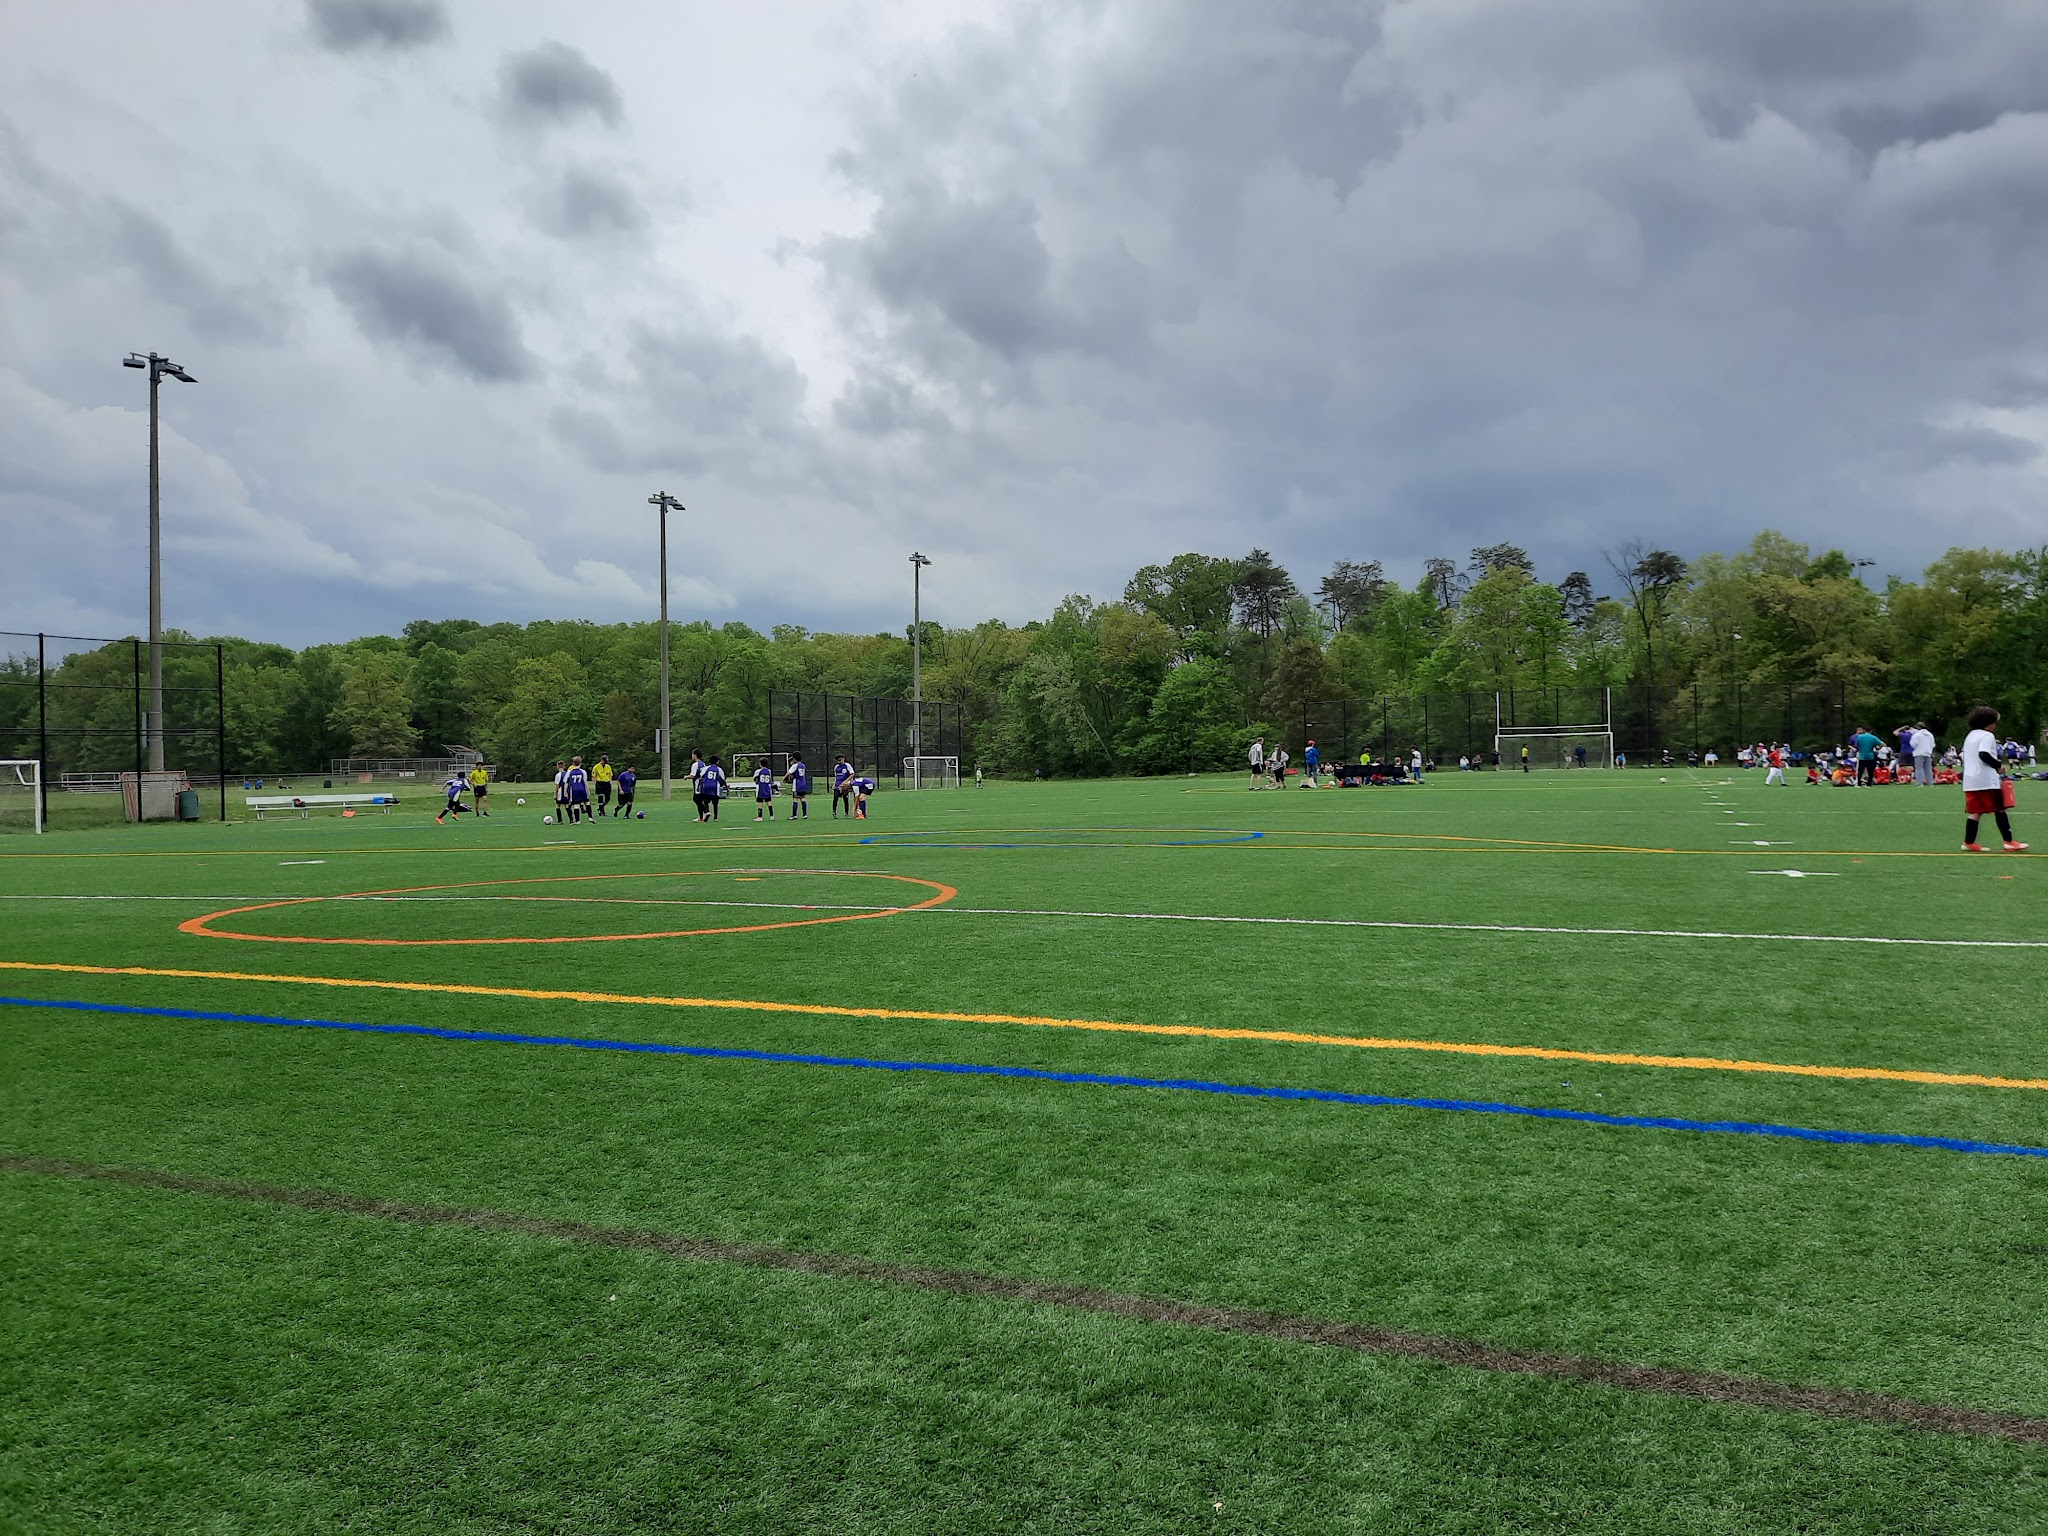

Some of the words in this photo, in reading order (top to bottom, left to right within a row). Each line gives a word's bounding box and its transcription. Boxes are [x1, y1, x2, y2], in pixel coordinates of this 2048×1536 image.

[571, 775, 582, 783] 77
[707, 771, 716, 779] 61
[759, 774, 770, 783] 66
